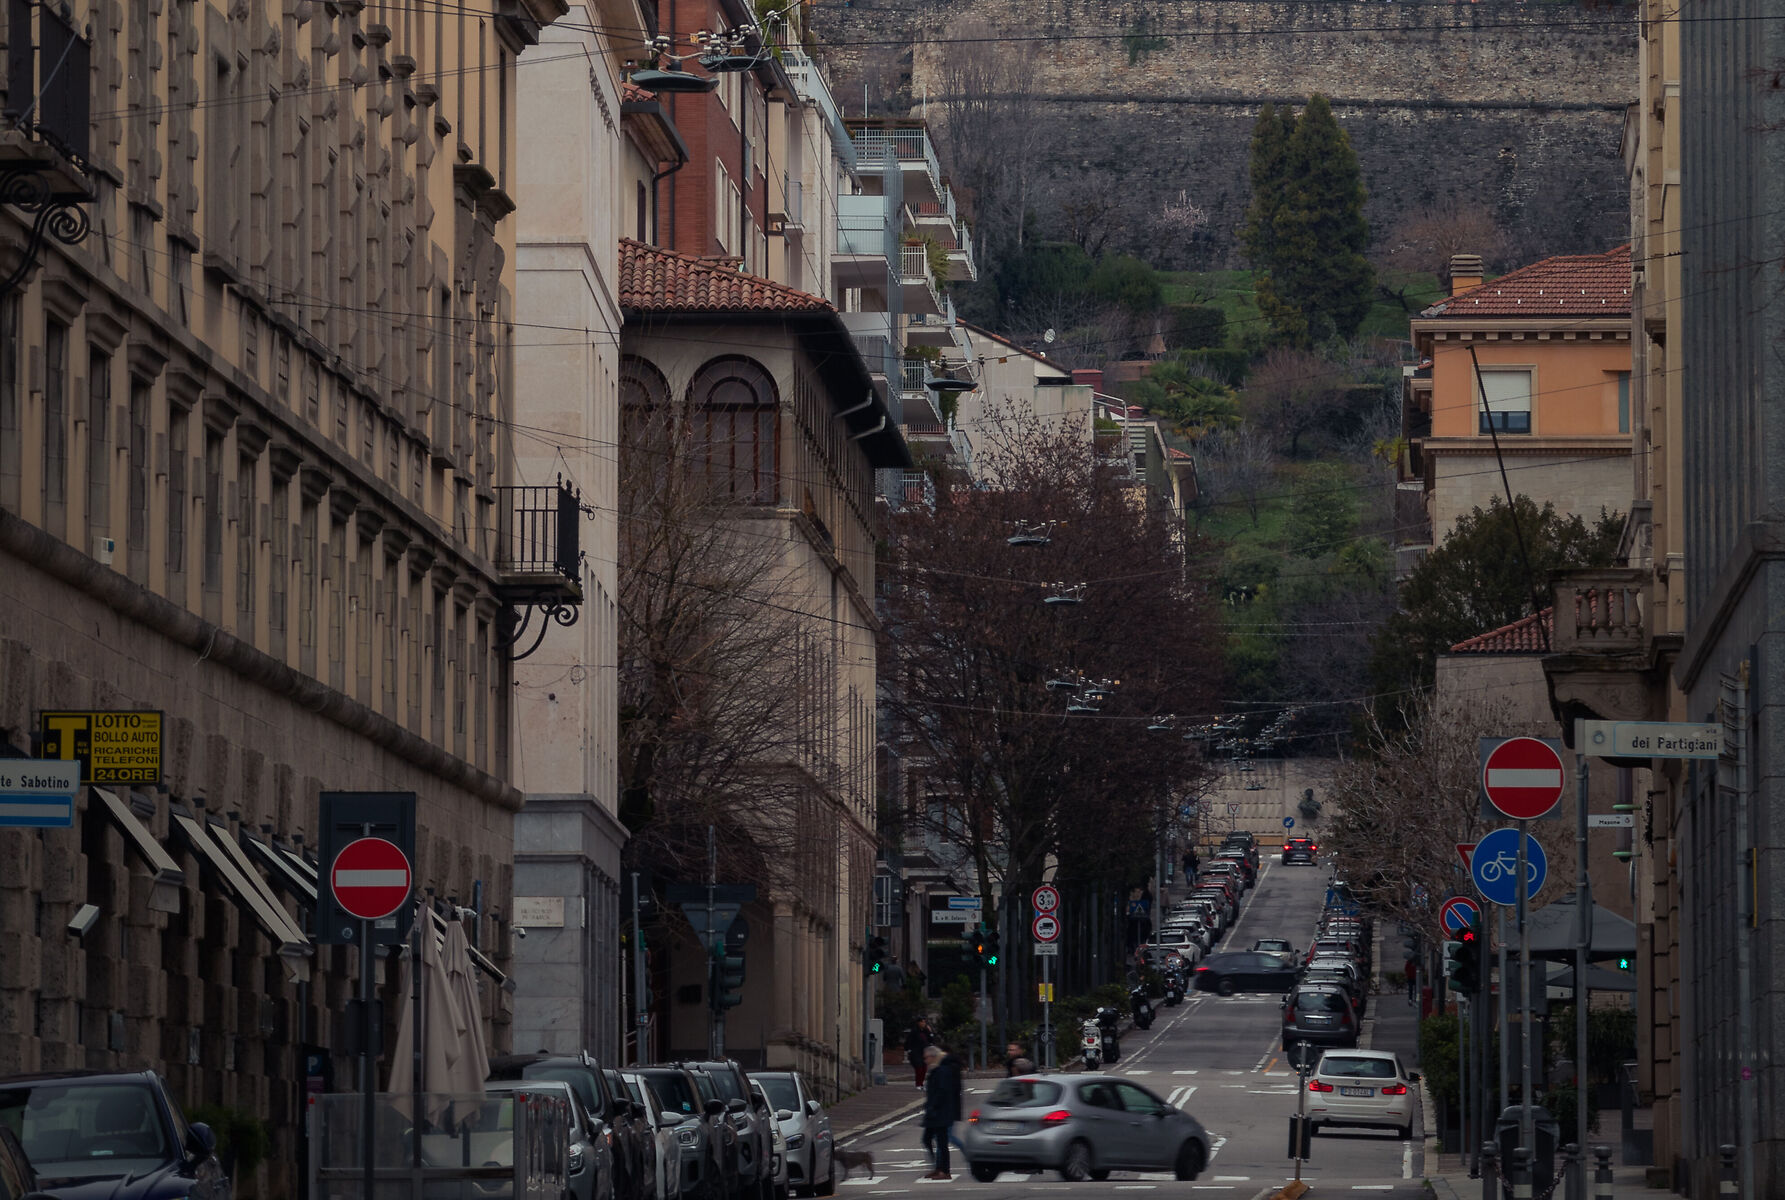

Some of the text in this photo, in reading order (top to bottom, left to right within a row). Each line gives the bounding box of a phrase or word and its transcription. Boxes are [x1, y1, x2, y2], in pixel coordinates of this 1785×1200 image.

[95, 714, 141, 728] LOTTO
[94, 731, 159, 743] BOLLO AUTO
[94, 746, 159, 755] RICARICHE
[1632, 736, 1718, 753] dei Partigiani
[94, 755, 159, 764] TELEFONI
[20, 775, 70, 789] Sabotino
[307, 1055, 318, 1072] P
